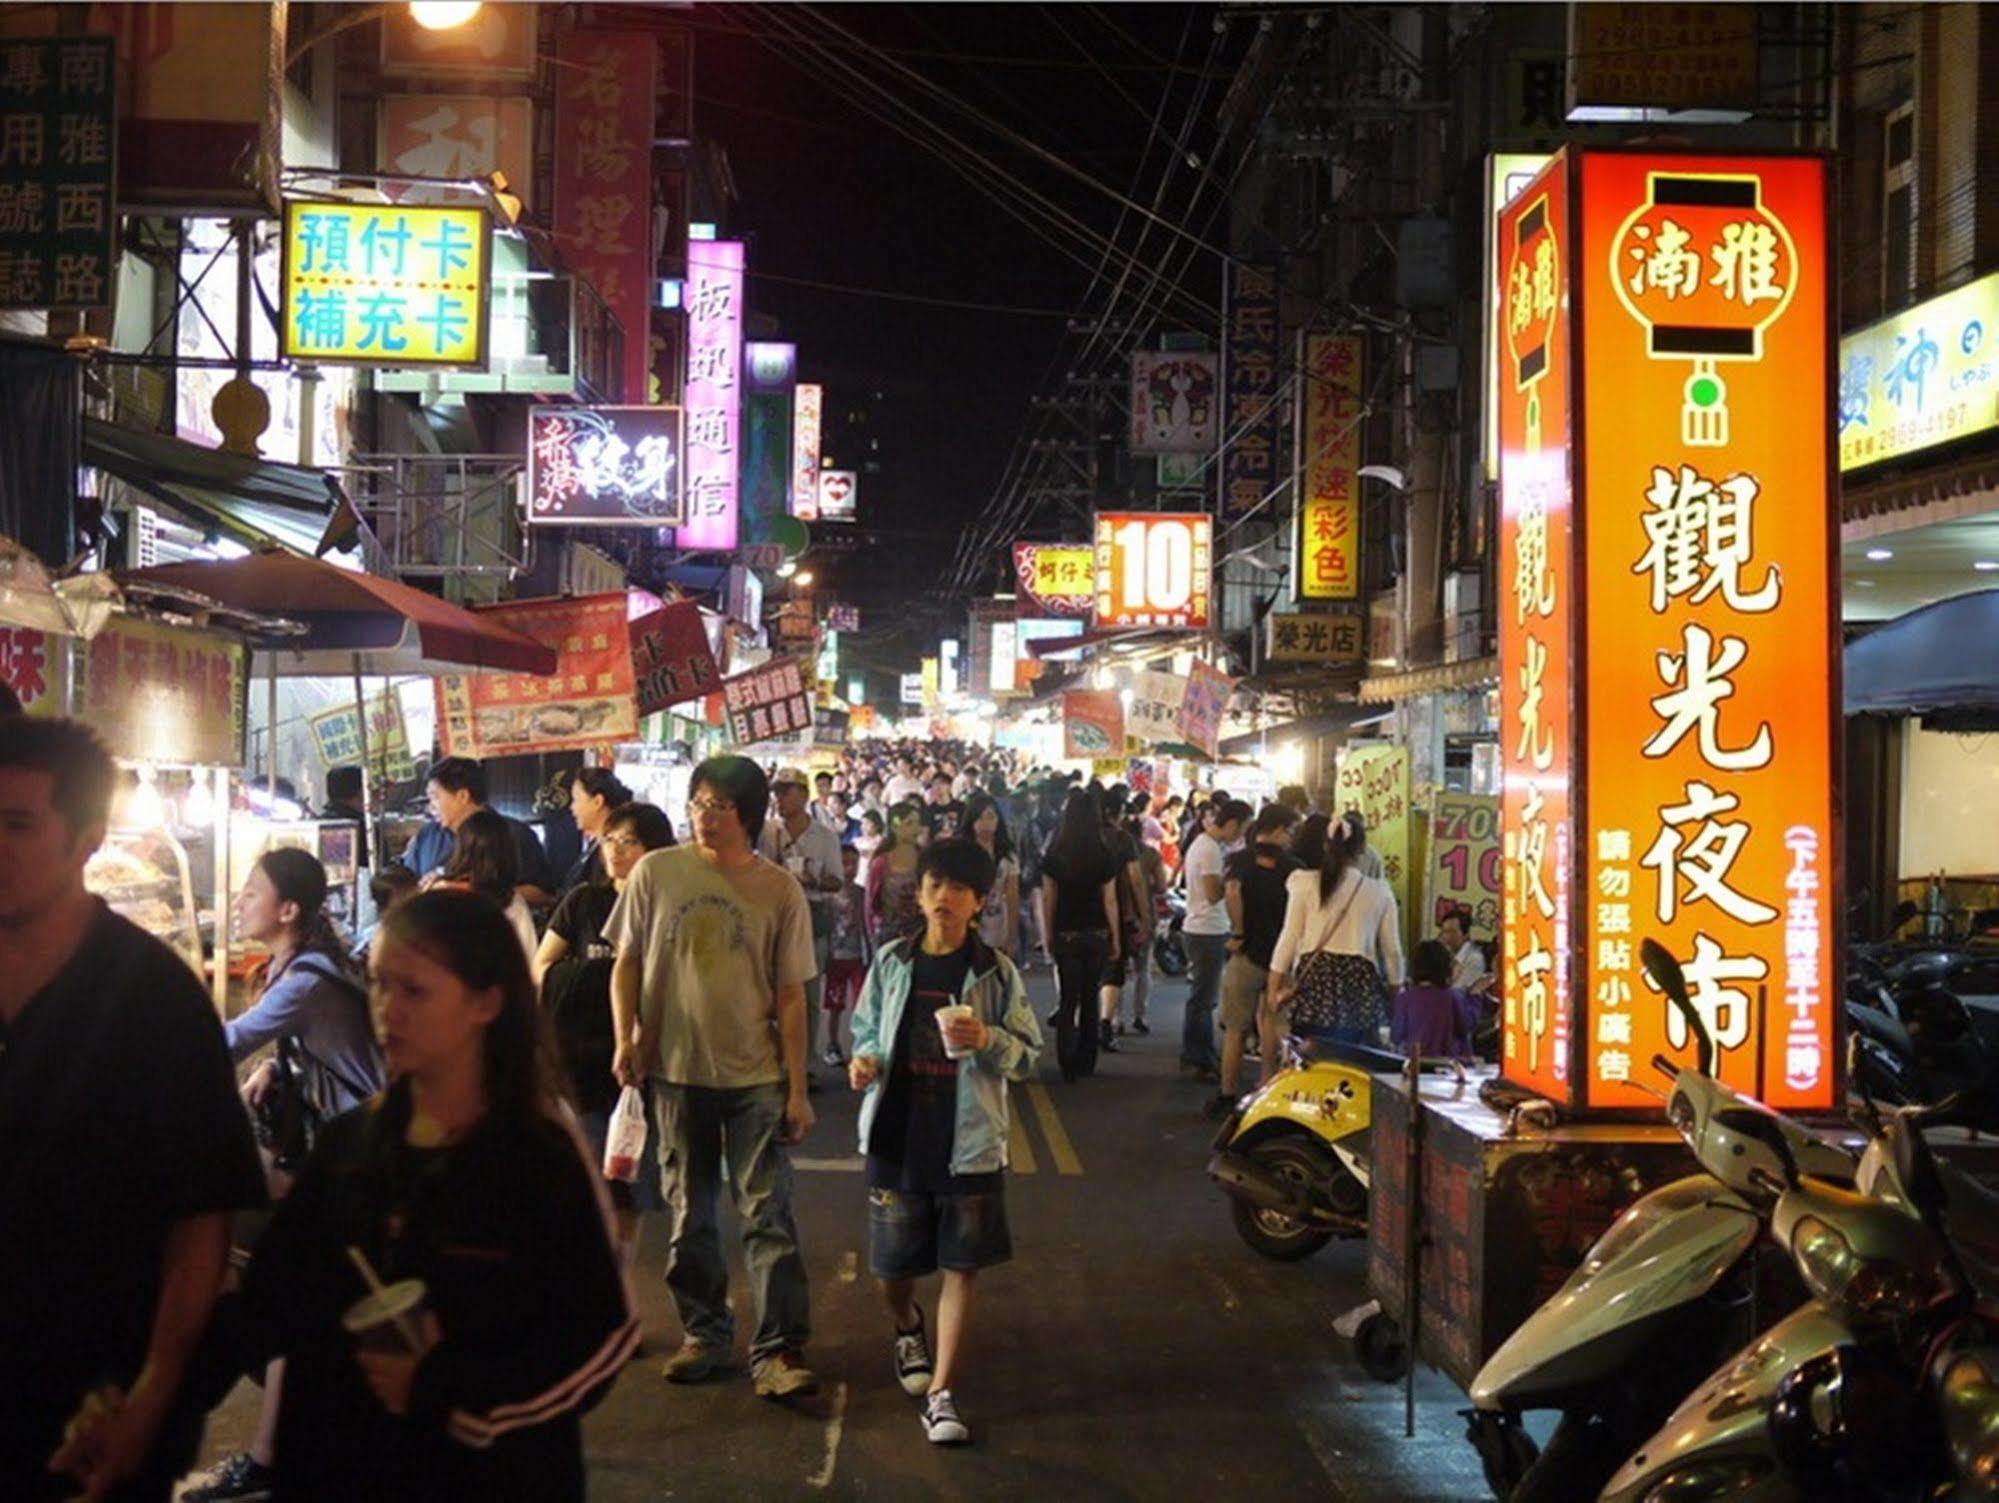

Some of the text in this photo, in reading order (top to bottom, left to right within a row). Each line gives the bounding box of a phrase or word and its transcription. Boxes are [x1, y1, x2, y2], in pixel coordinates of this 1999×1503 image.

[56, 43, 107, 303] 南雅西路
[298, 212, 473, 278] 預付卡
[1629, 219, 1786, 306] 湳雅
[295, 289, 469, 354] 補充卡
[1313, 342, 1354, 583] 榮光快速彩色
[1115, 521, 1192, 609] 10
[1274, 624, 1356, 655] 榮光店
[1632, 464, 1783, 1078] 觀光夜市
[1597, 830, 1631, 1082] 請勿張貼小廣告
